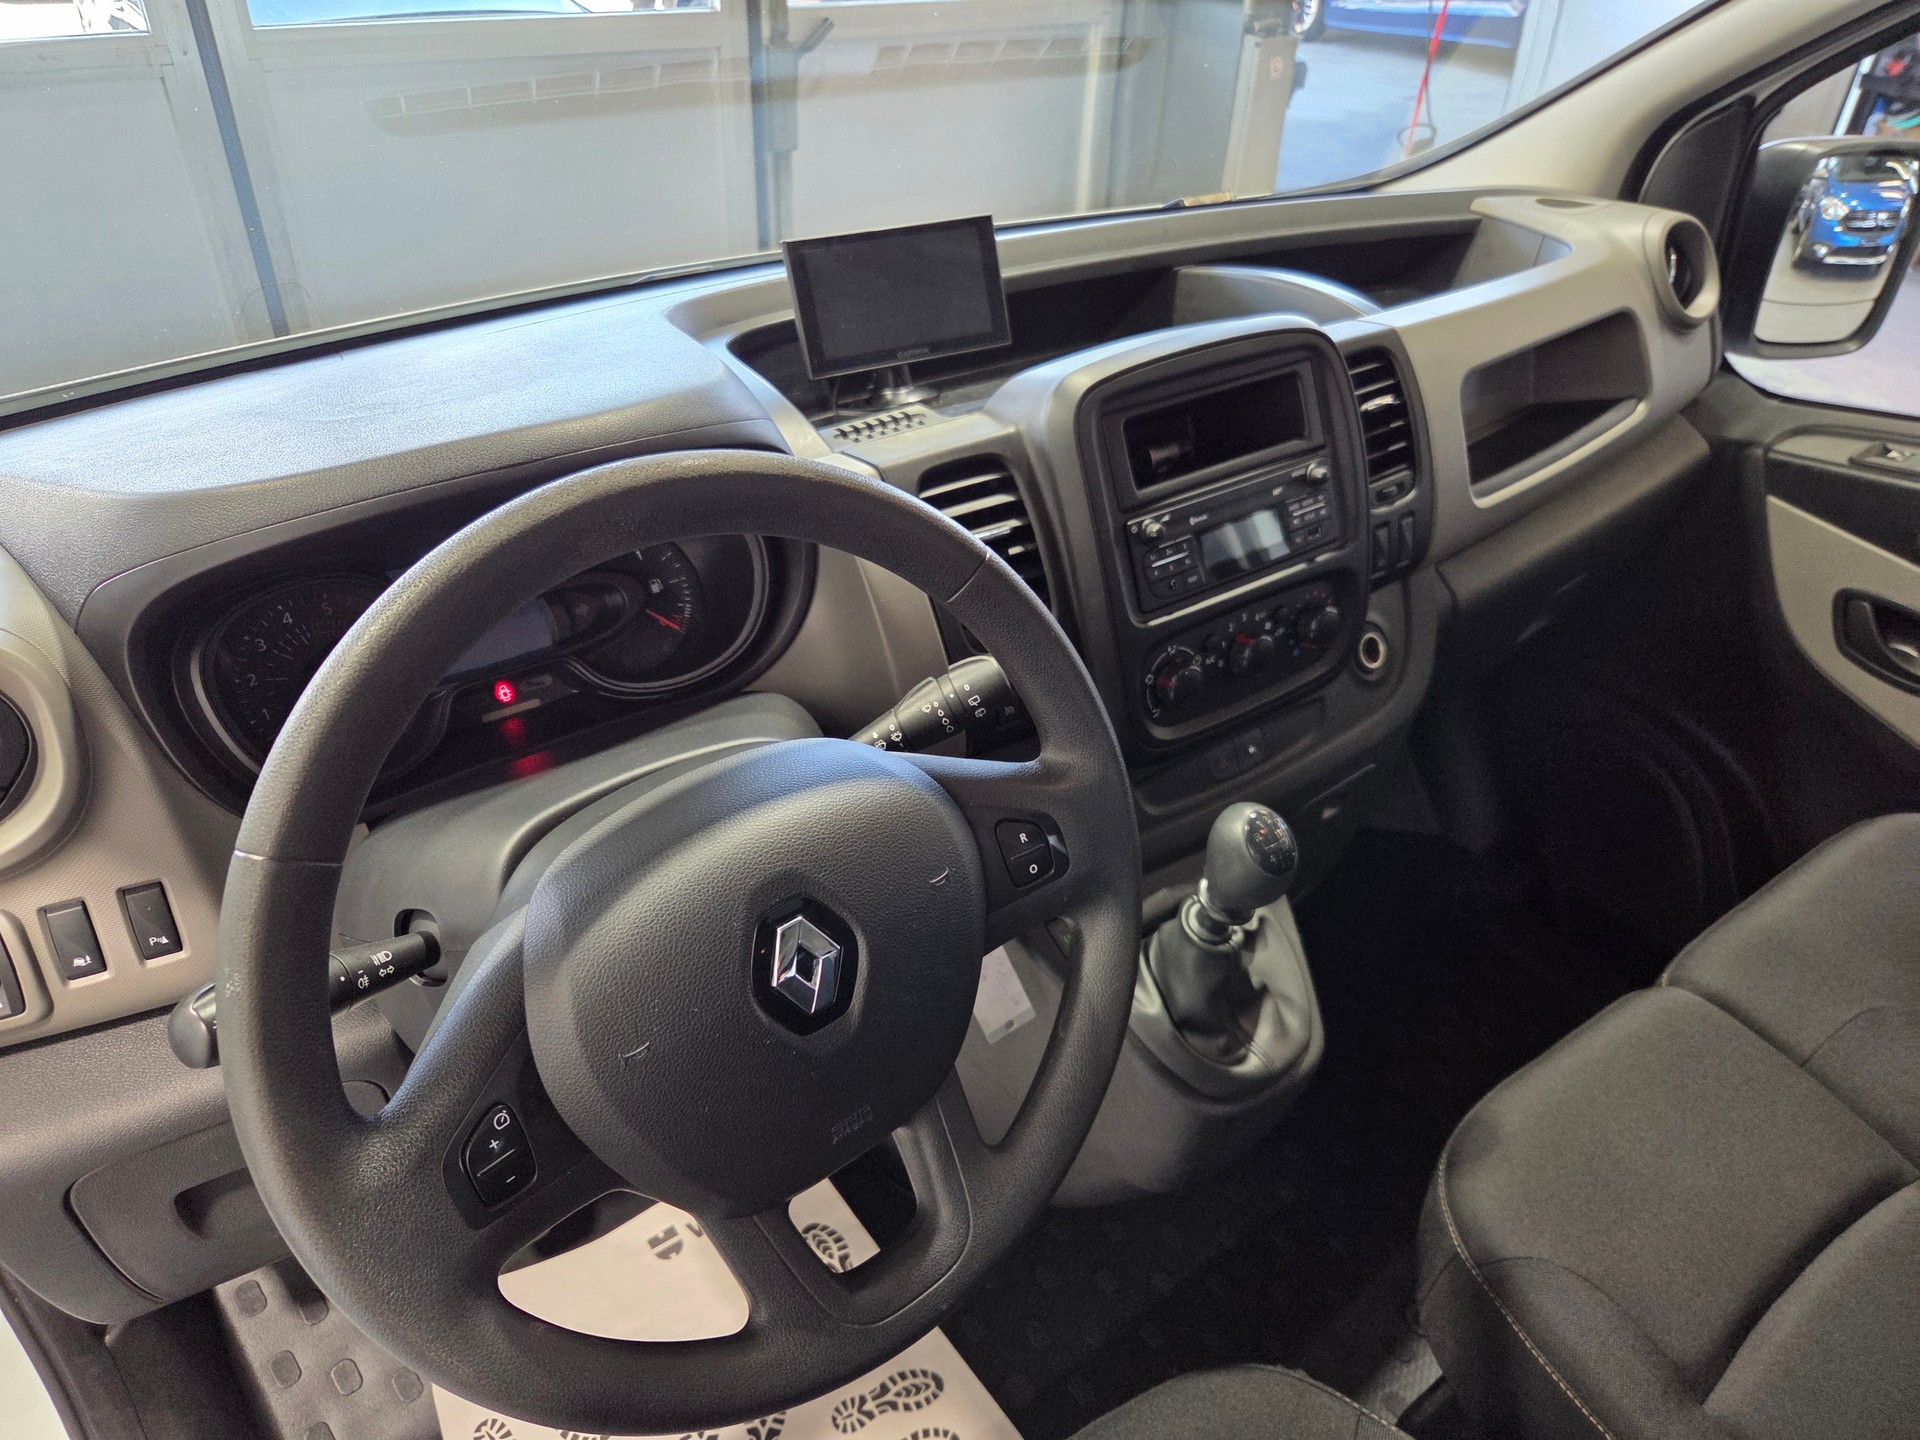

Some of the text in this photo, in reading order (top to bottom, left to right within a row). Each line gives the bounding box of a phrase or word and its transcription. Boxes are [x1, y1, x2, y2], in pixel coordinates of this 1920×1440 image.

[283, 612, 293, 624] 4
[254, 638, 266, 651] 3
[246, 674, 259, 686] 2
[262, 708, 270, 720] 1
[1019, 832, 1029, 844] R
